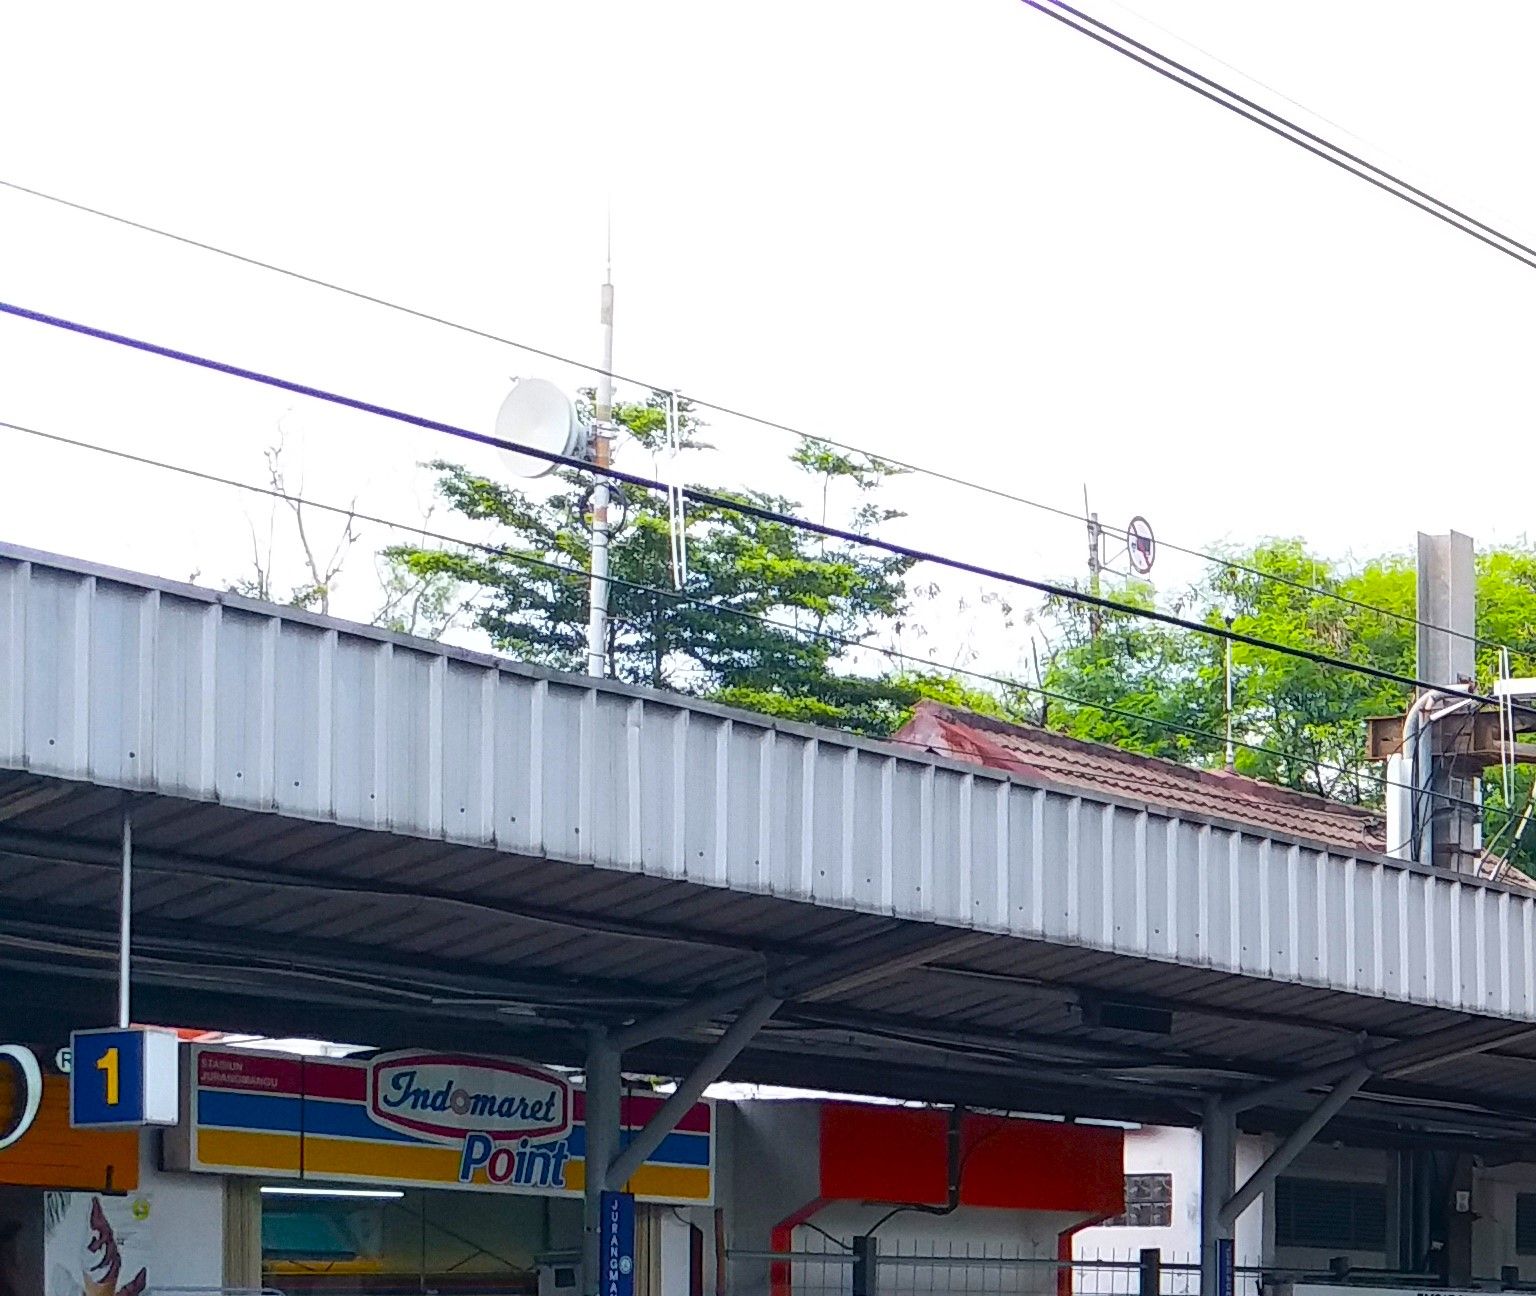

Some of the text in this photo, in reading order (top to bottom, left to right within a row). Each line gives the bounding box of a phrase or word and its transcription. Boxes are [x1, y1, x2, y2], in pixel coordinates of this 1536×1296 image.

[96, 1047, 119, 1105] 1
[383, 1069, 557, 1122] Indomaret
[460, 1134, 569, 1187] Point
